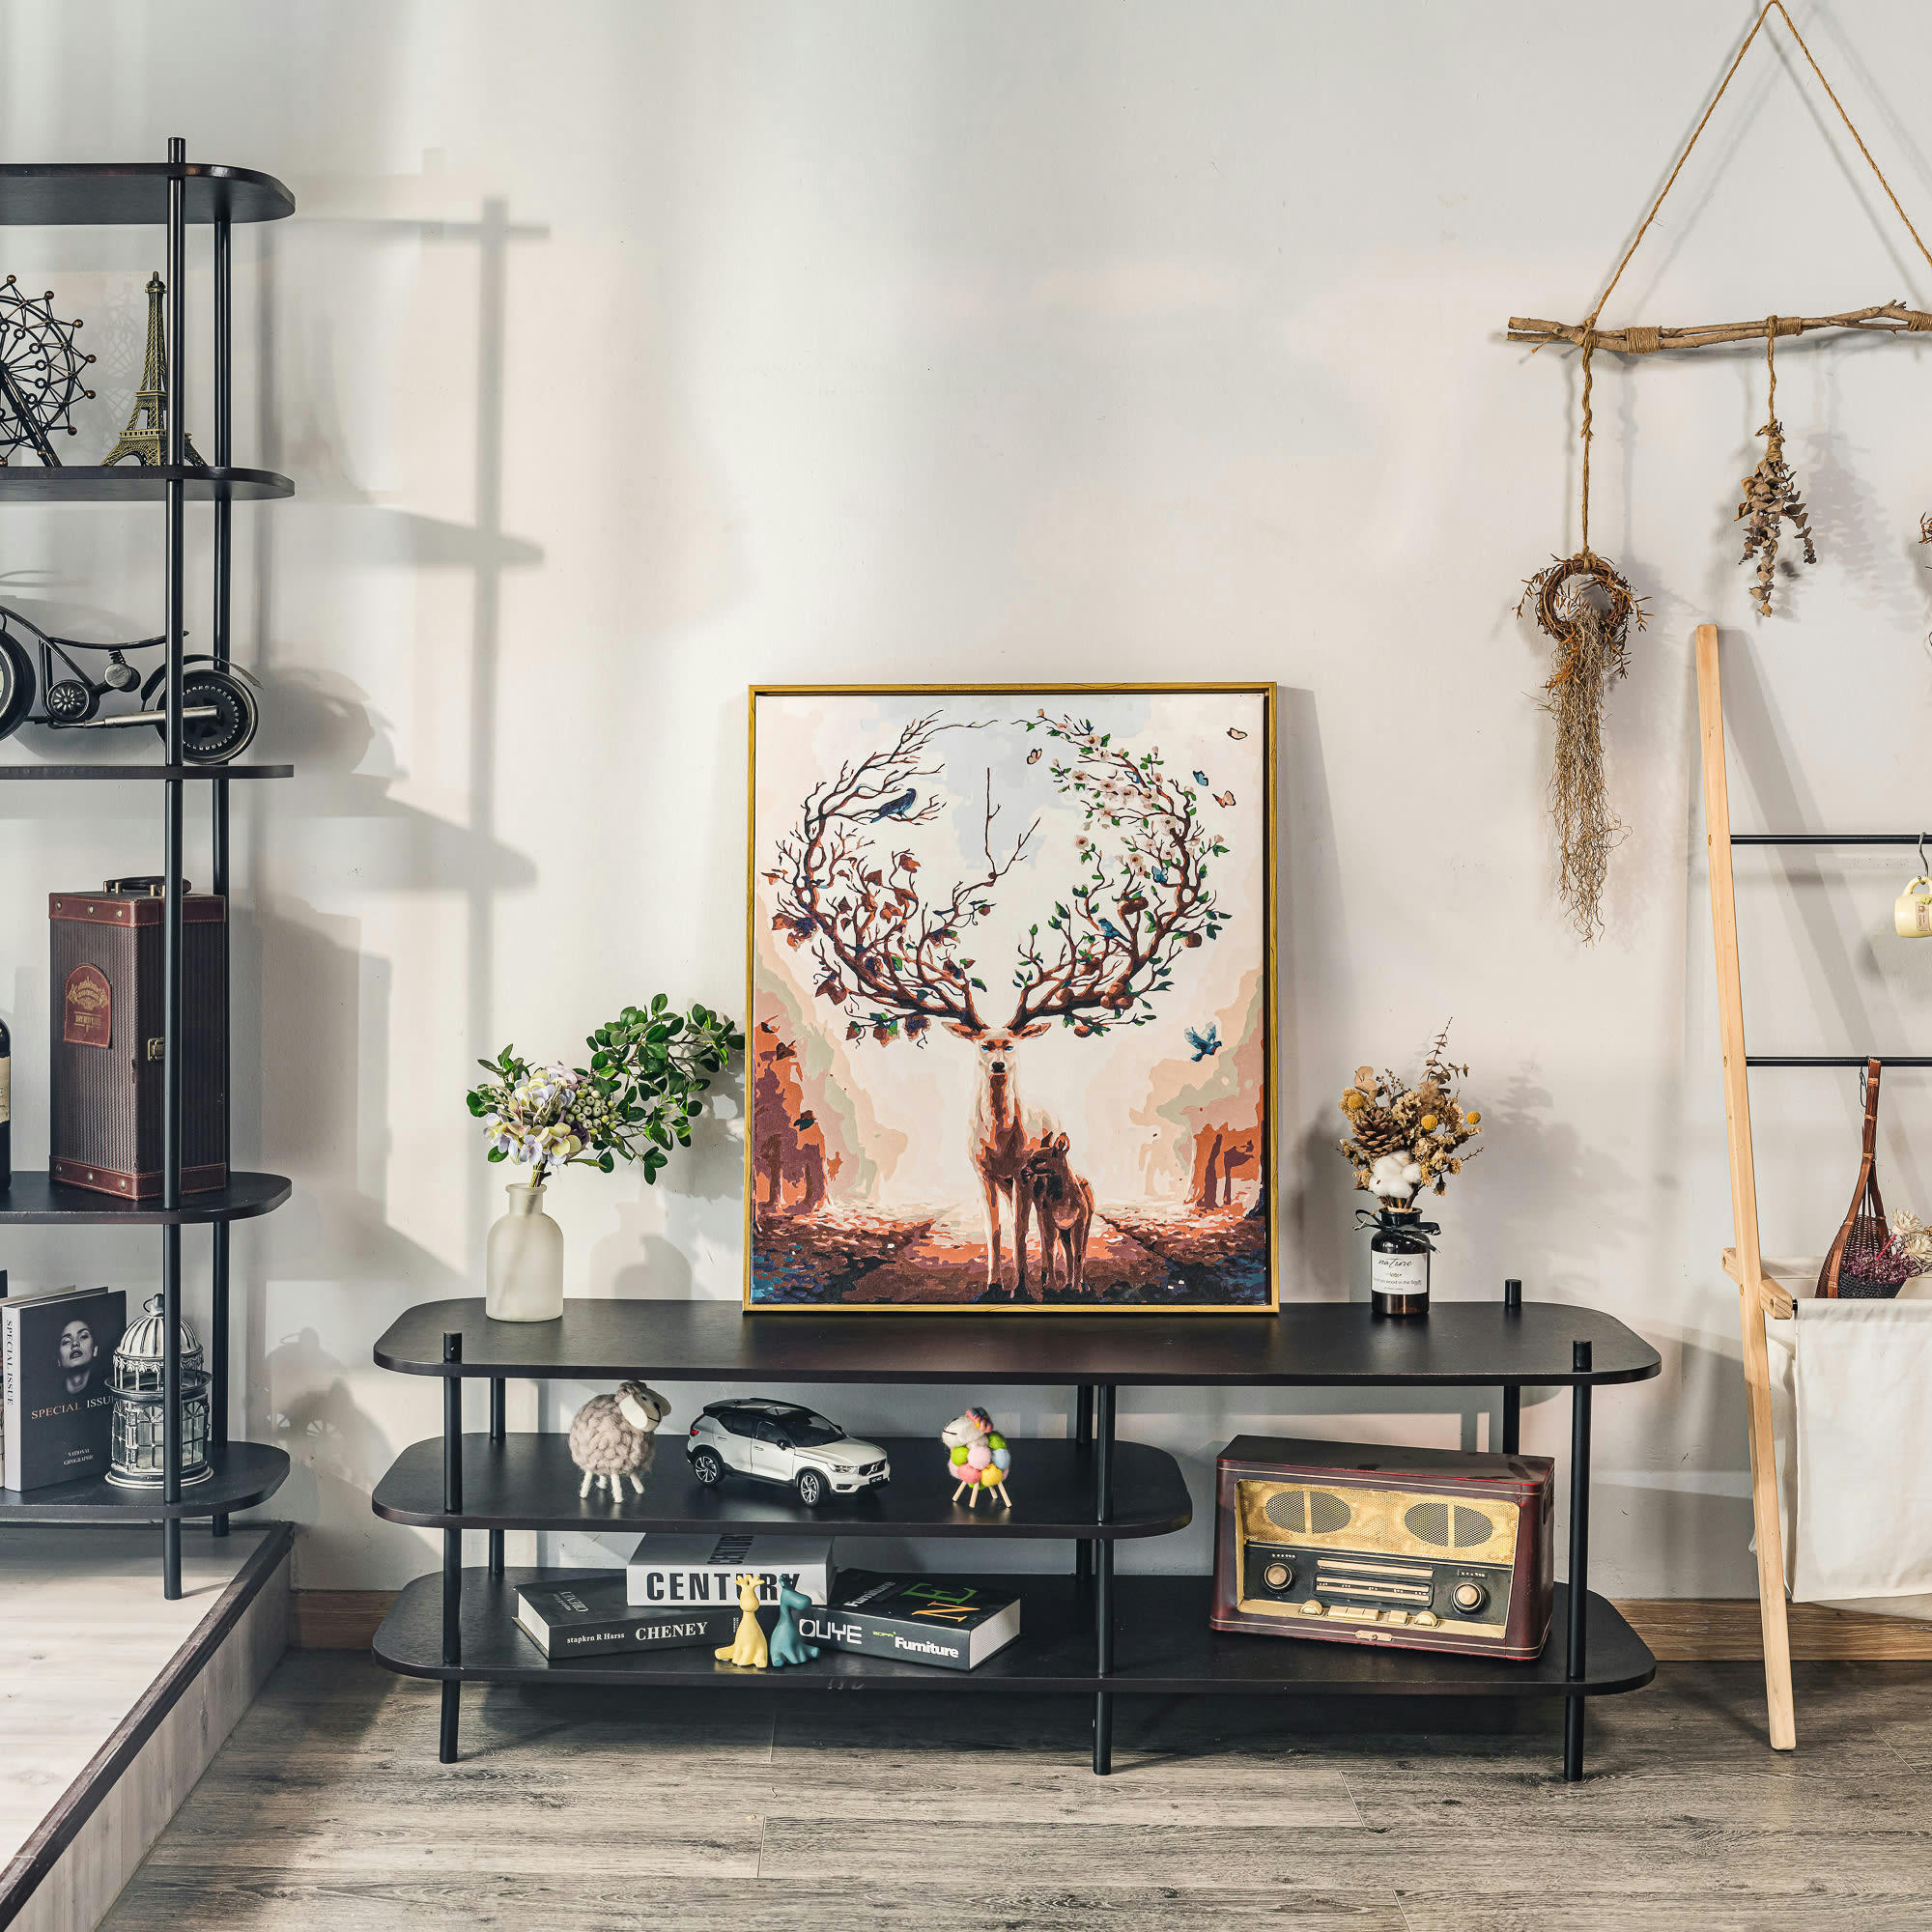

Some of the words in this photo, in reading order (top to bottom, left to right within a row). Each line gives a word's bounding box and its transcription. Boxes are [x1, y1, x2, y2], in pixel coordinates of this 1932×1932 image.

[31, 1403, 81, 1419] SPECIAL
[635, 1621, 708, 1641] CHENEY
[895, 1636, 959, 1659] Furniture
